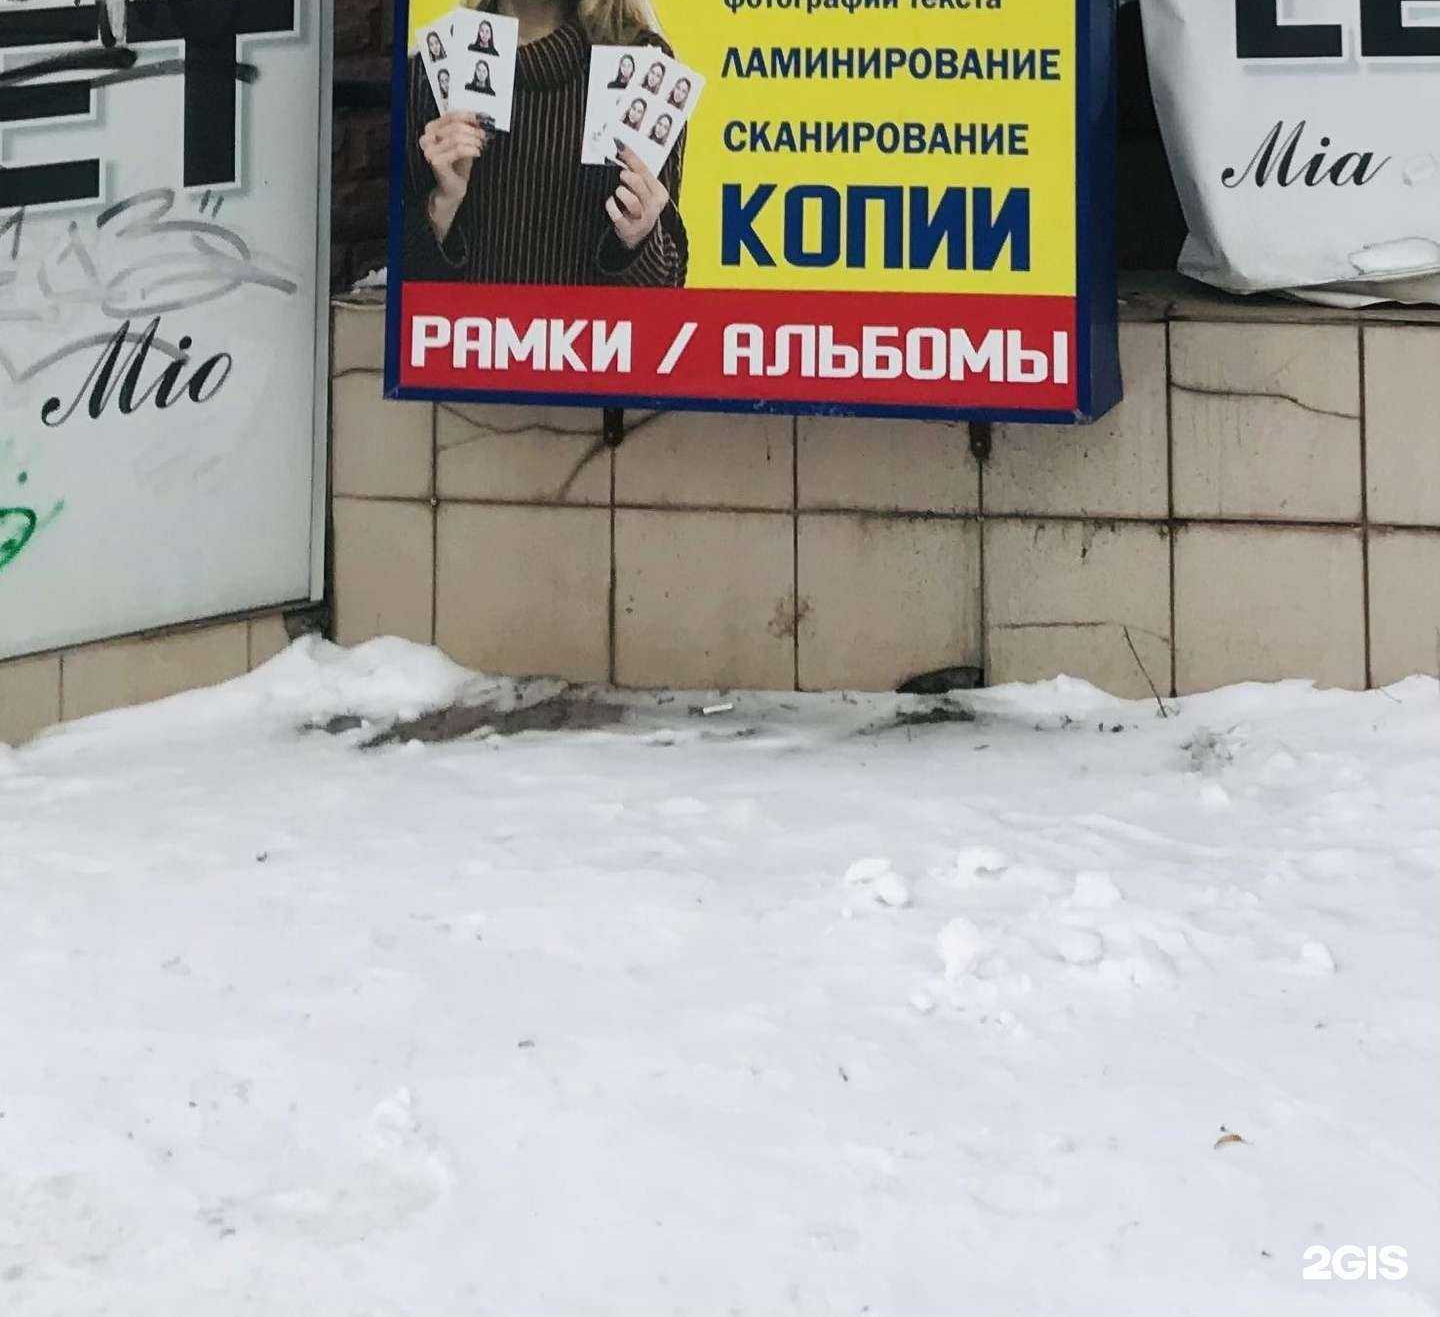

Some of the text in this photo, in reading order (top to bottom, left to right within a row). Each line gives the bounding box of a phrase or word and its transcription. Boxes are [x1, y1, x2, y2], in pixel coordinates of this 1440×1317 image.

[721, 47, 1061, 81] ЛАМИНИРОВАНИЕ
[723, 120, 1029, 156] СКАНИРОВАНИЕ
[1221, 120, 1391, 189] Mia
[721, 183, 1031, 272] КОПИИ
[41, 316, 232, 427] Mio
[410, 315, 632, 373] РАМКИ
[722, 323, 1069, 384] АЛЬБОМЫ
